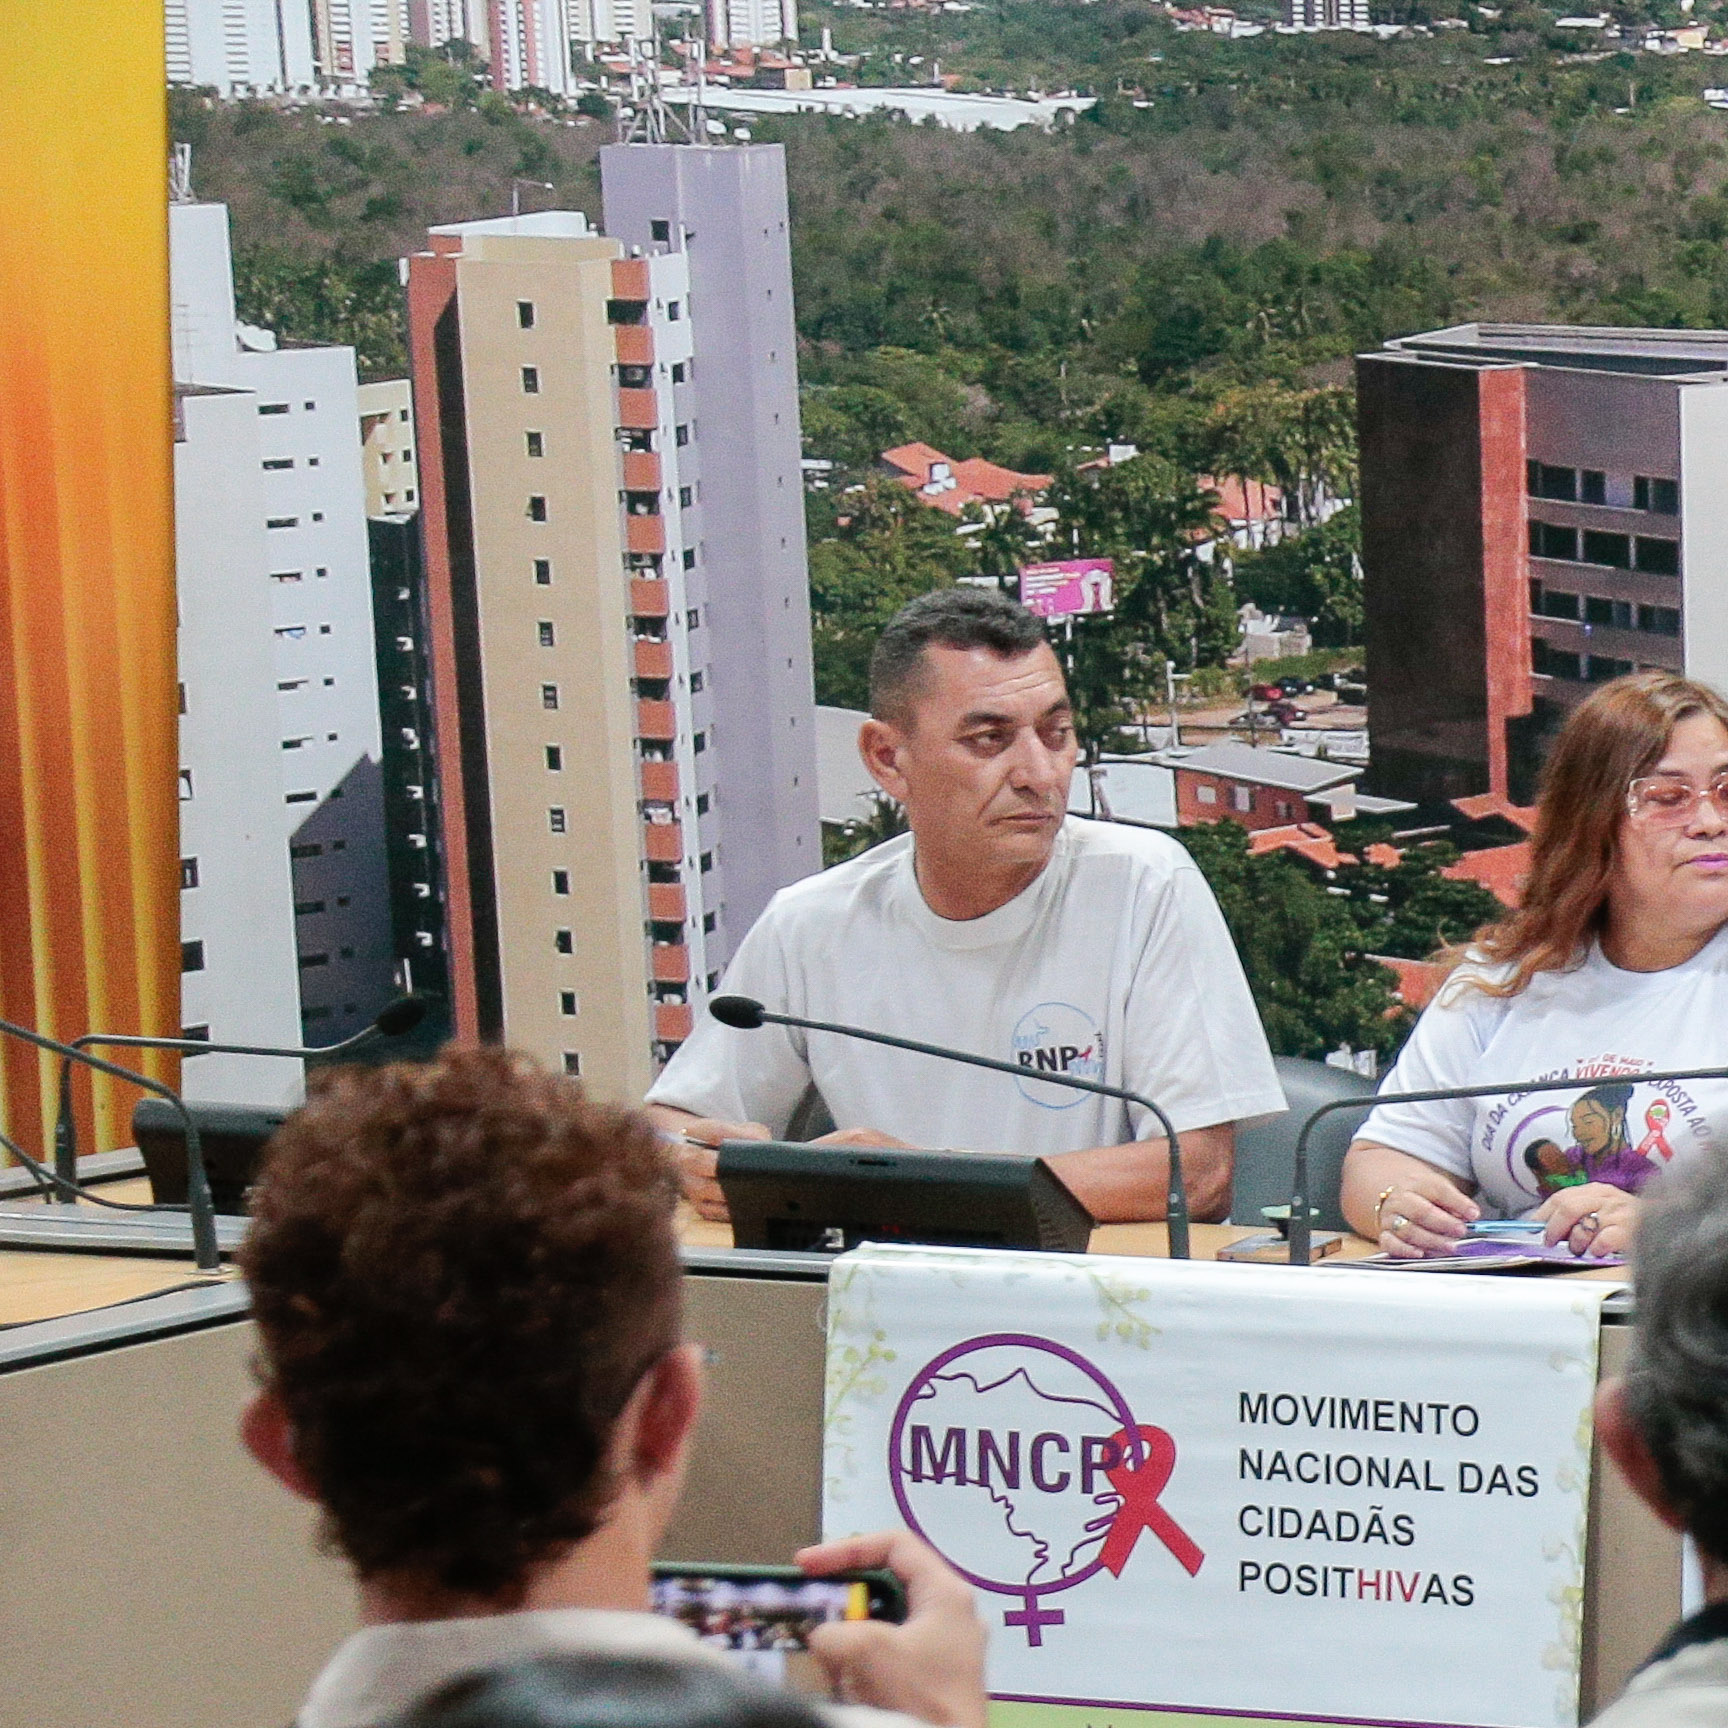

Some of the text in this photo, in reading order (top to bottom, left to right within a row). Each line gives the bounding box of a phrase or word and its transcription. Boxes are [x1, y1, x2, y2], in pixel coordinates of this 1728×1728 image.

[1239, 1391, 1480, 1437] MOVIMENTO
[911, 1424, 1123, 1494] MNCP
[1239, 1447, 1540, 1498] NACIONAL DAS
[1238, 1504, 1416, 1547] CIDADÃS
[1239, 1560, 1475, 1607] POSITHIVAS
